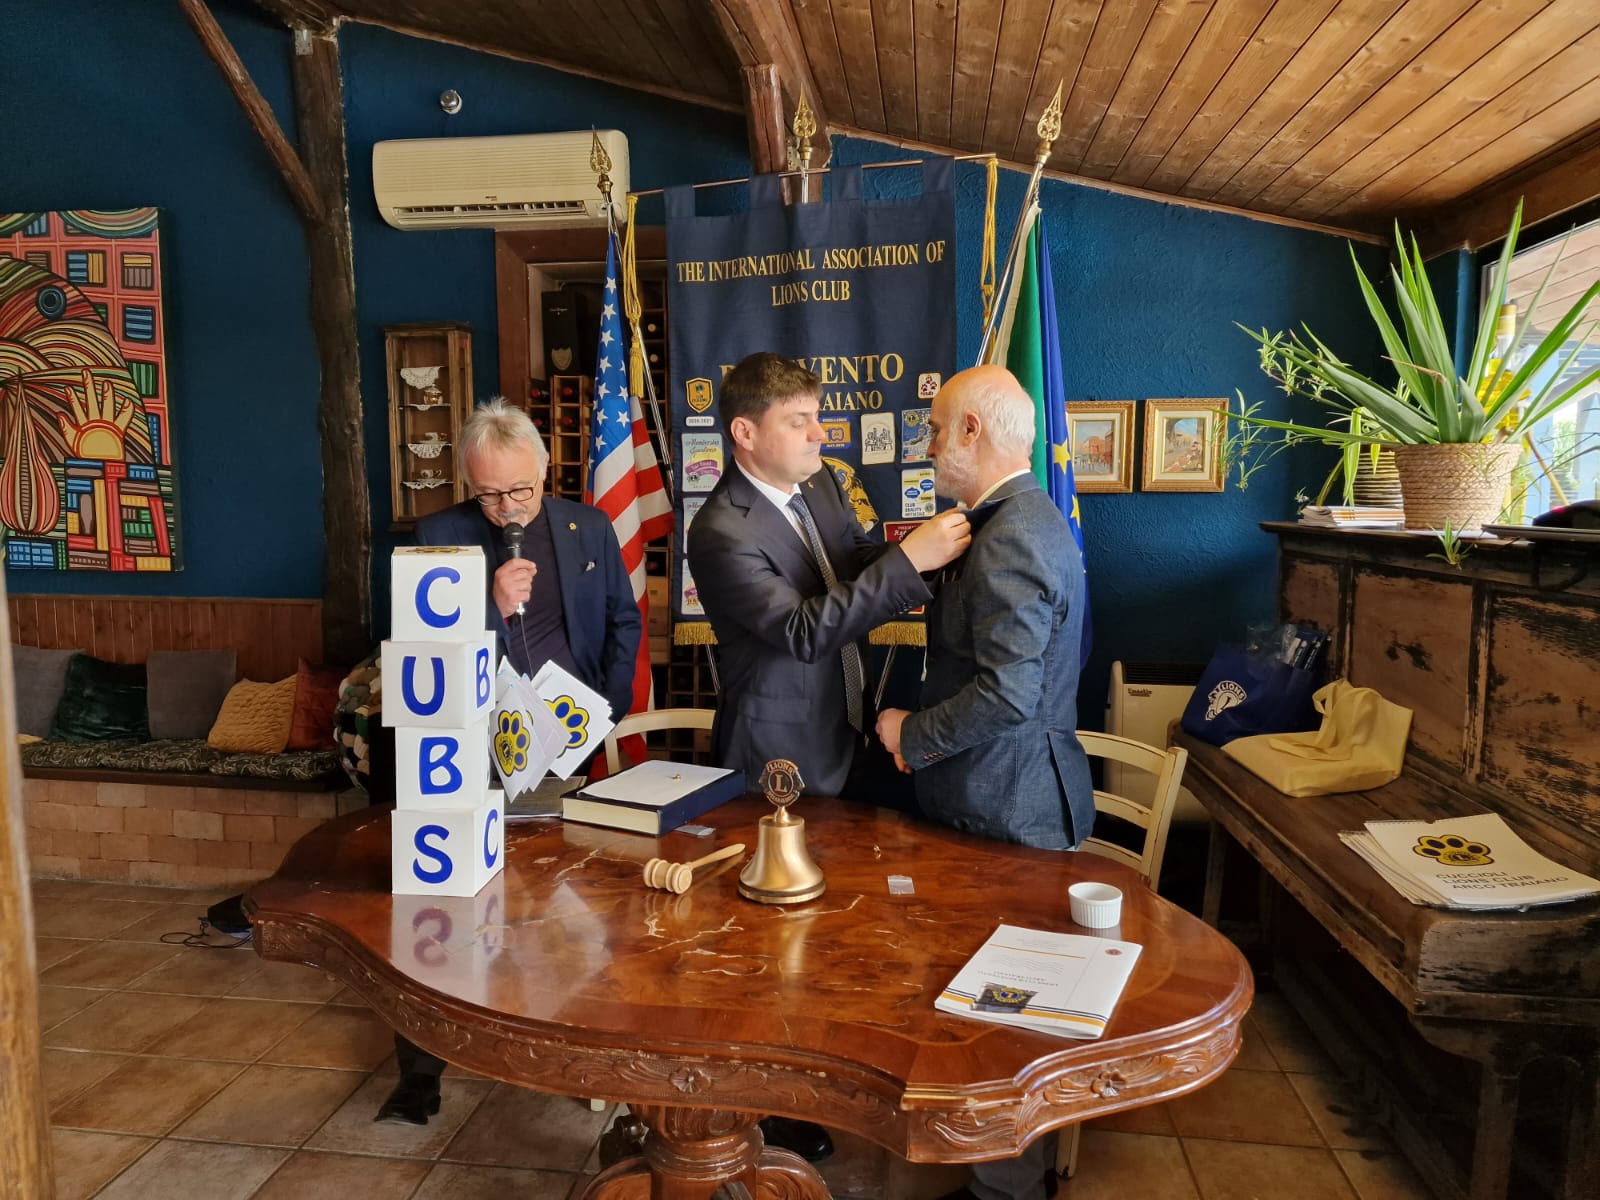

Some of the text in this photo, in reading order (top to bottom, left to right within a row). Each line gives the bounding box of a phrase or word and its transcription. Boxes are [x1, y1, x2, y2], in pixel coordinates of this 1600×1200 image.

[677, 240, 946, 282] THE INTERNATIONAL ASSOCIATION OF
[771, 280, 850, 306] LIONS CLUB
[818, 390, 883, 411] AIANO
[415, 567, 461, 628] C
[402, 656, 445, 716] U
[476, 647, 490, 708] B
[1221, 681, 1245, 699] LIONS
[419, 737, 463, 794] B
[412, 825, 453, 884] S
[483, 809, 498, 869] C
[1436, 871, 1508, 879] CUCCIOLI
[1492, 874, 1536, 882] CLUB
[1500, 876, 1569, 888] TRAIANO
